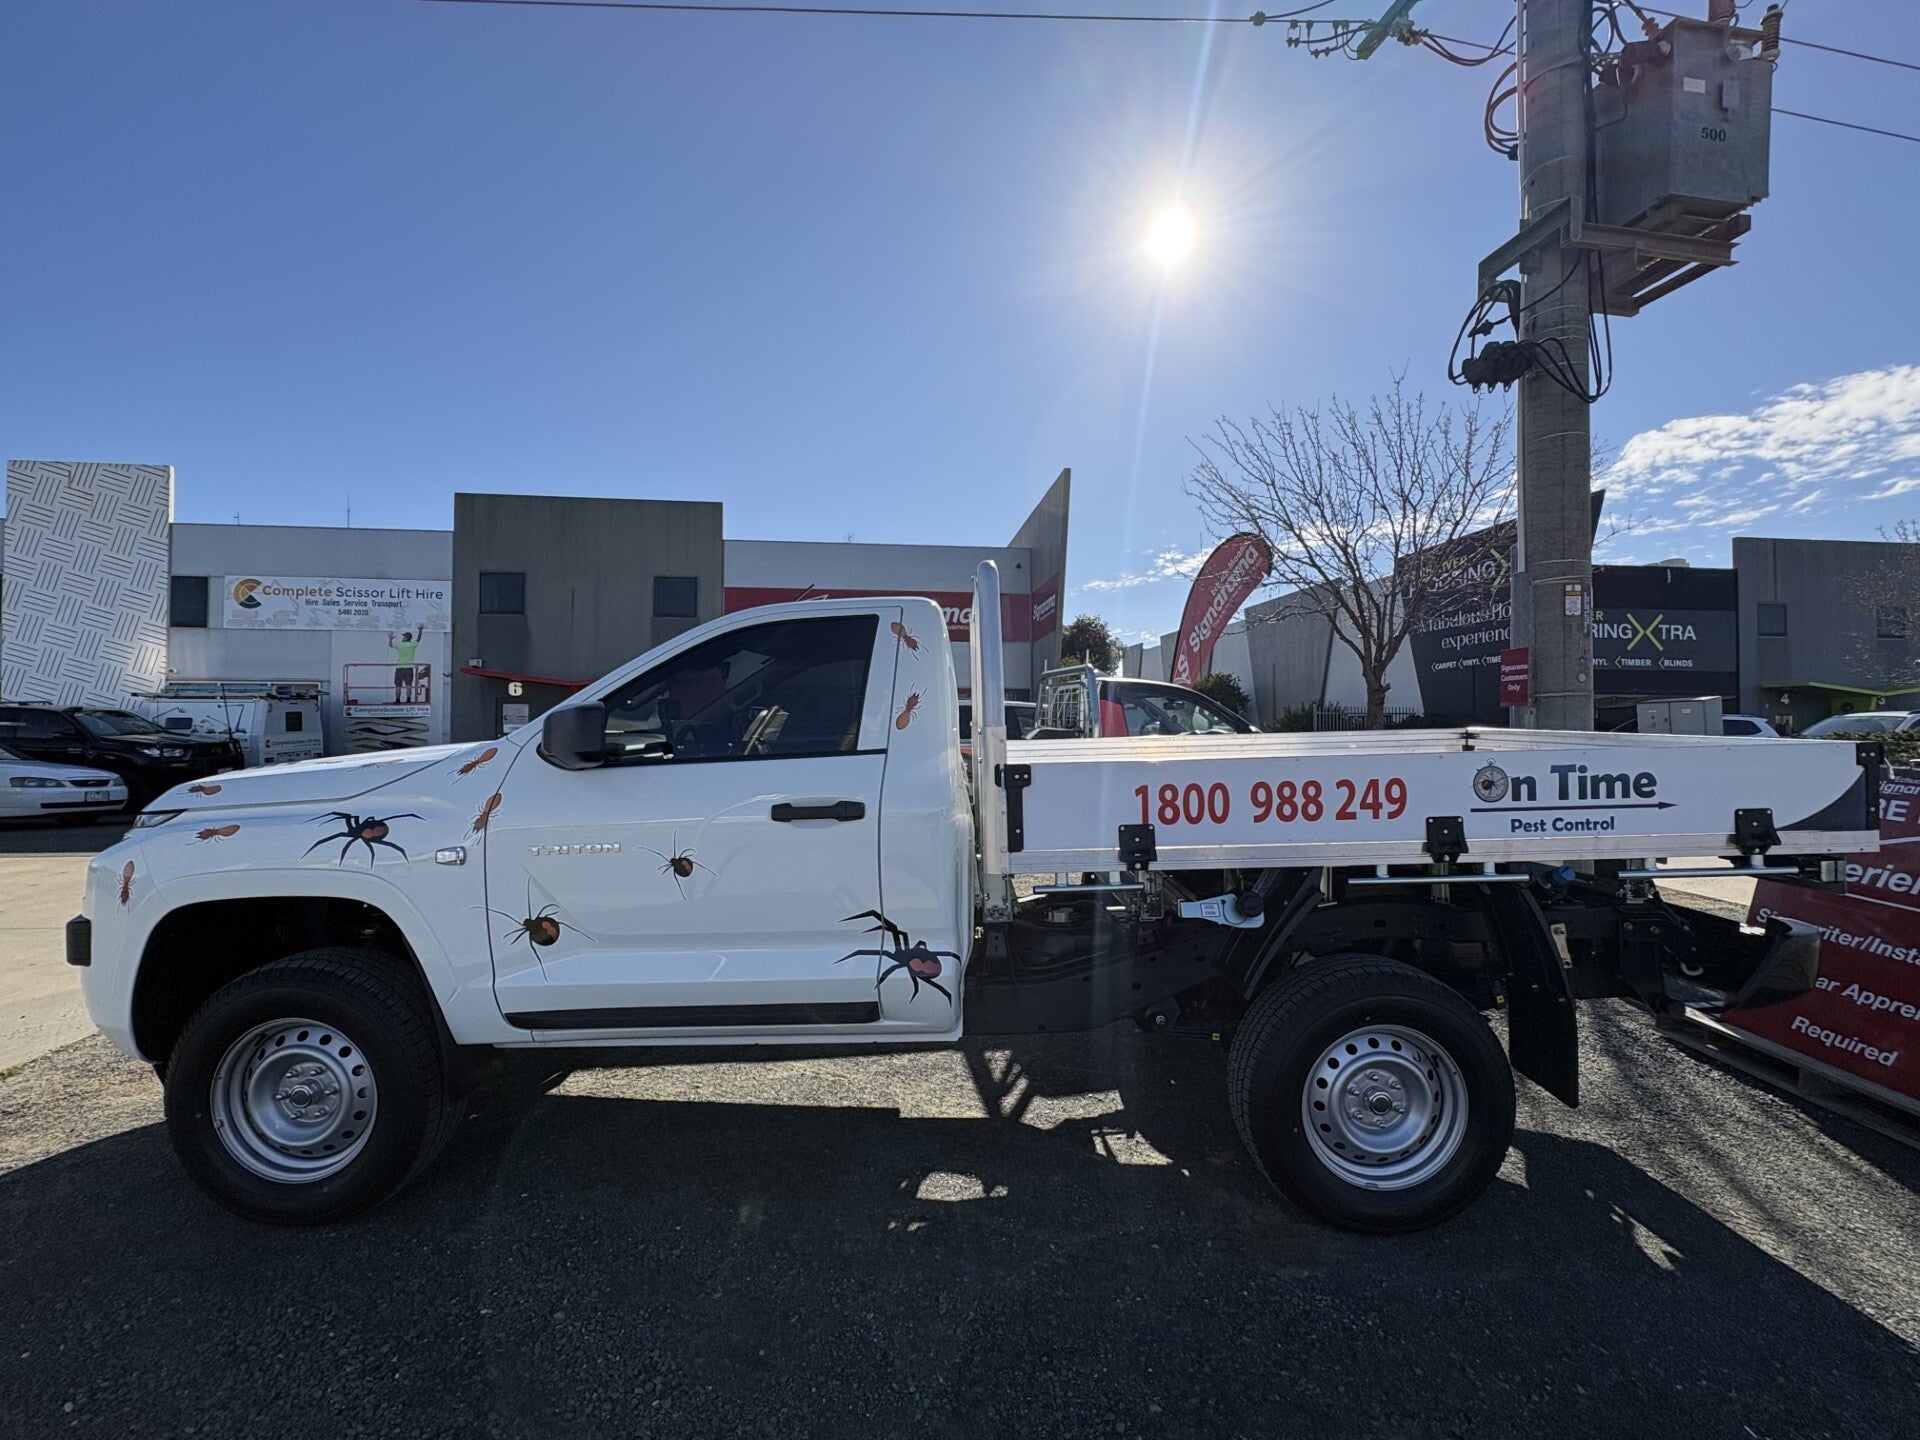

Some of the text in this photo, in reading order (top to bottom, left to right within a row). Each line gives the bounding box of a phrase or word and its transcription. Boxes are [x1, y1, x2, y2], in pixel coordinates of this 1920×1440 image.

[1701, 127, 1727, 142] 500
[262, 585, 444, 600] Complete Scissor Lift Hire
[1189, 545, 1259, 653] Signarama
[322, 599, 340, 607] Sales
[343, 599, 368, 607] Service
[371, 600, 403, 609] Transport
[1435, 660, 1457, 670] CARPET
[1462, 658, 1480, 667] VINYL
[1621, 658, 1652, 667] TIMBER
[1664, 659, 1693, 667] BLINDS
[508, 681, 523, 696] 6
[1507, 683, 1521, 693] Only
[1780, 693, 1790, 704] 4
[1550, 764, 1658, 801] Time
[1879, 780, 1920, 795] ignar
[1134, 777, 1408, 825] 1800 988 249
[1510, 816, 1615, 833] Pest Control
[528, 843, 621, 856] TRITON
[1790, 1015, 1899, 1067] Required
